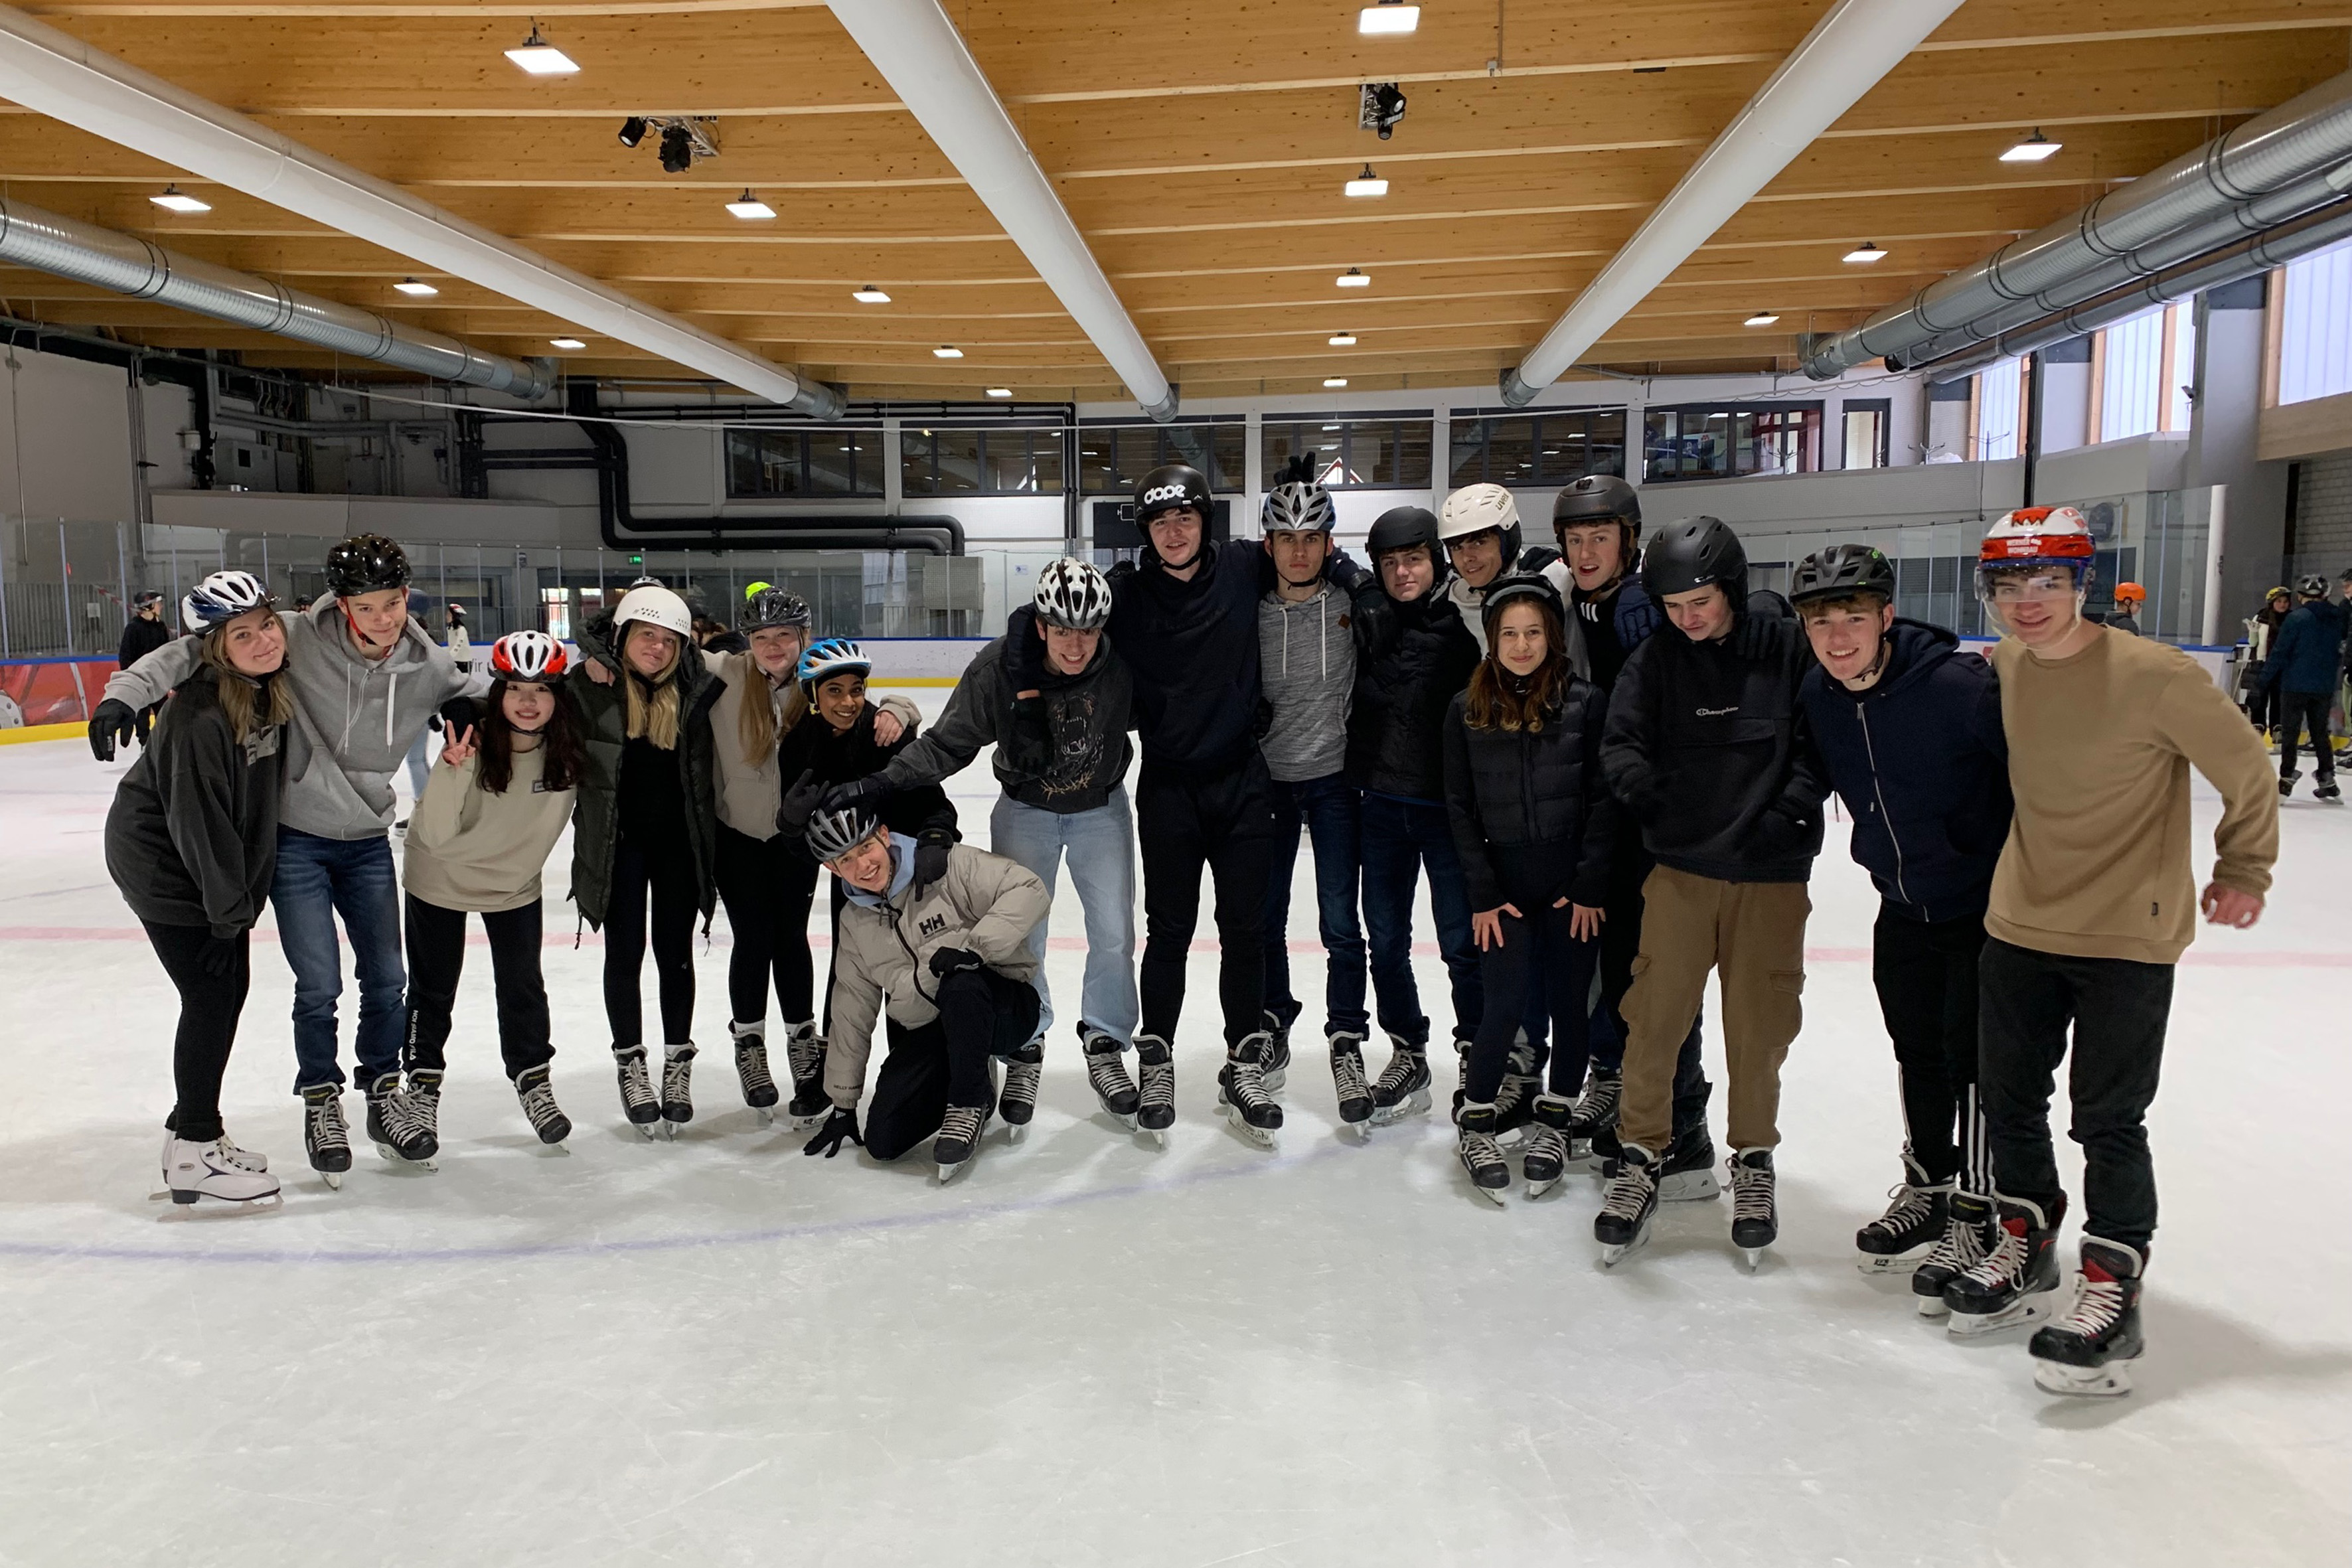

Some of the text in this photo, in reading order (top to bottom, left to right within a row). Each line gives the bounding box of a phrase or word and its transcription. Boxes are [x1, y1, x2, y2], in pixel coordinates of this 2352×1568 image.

[1144, 485, 1186, 505] dope
[1495, 492, 1510, 510] uvex
[472, 659, 483, 672] ir
[1704, 706, 1739, 716] Champion
[918, 913, 946, 935] HH
